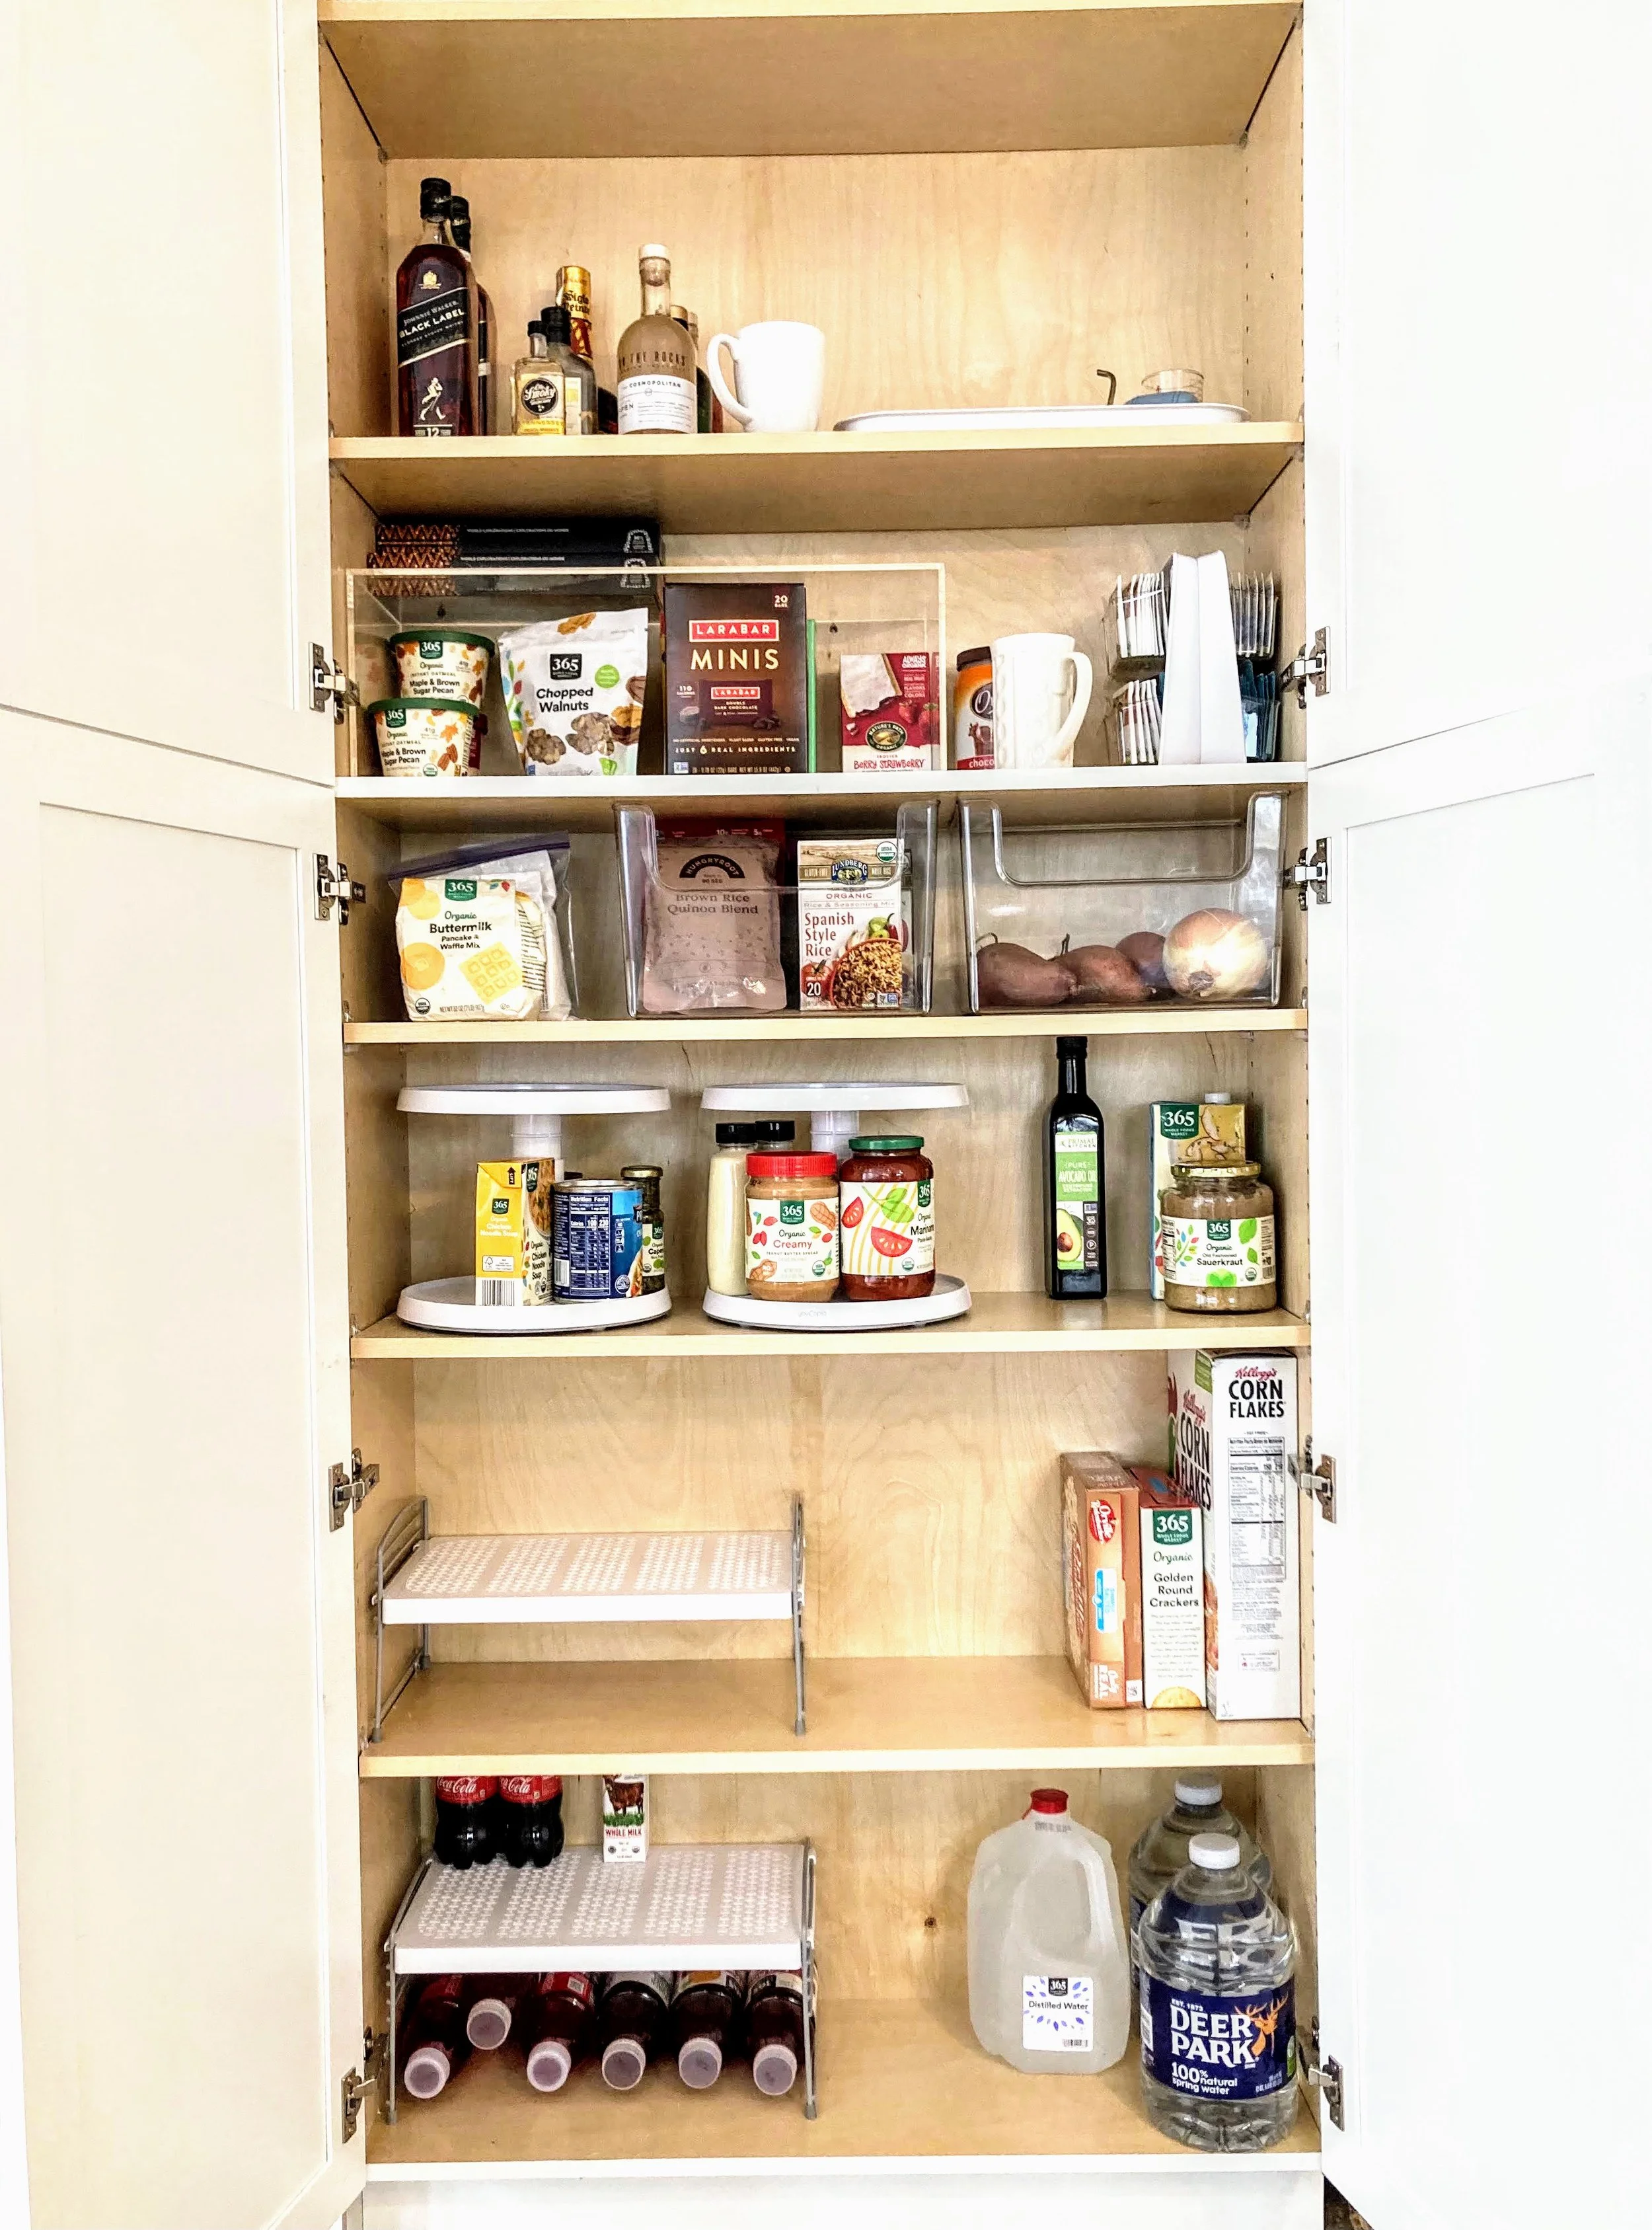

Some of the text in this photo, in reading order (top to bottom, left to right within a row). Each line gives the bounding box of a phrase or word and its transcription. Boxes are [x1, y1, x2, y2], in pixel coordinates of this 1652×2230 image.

[399, 309, 465, 338] BLACK LABEL
[426, 427, 441, 436] 12
[774, 595, 788, 603] 20
[696, 624, 770, 635] LARABAR
[552, 658, 580, 672] 365
[690, 648, 779, 670] MINIS
[437, 678, 461, 687] Brown
[536, 687, 593, 700] Chopped
[539, 701, 589, 712] Walnuts
[699, 745, 708, 755] 6
[685, 857, 739, 875] HUNGRYROOT
[831, 859, 868, 876] LUNDBERG
[447, 882, 474, 892] 365
[676, 893, 750, 902] Brown Rice
[667, 904, 759, 915] Quinoa Blend
[444, 910, 477, 922] Organic
[804, 911, 854, 929] Spanish
[430, 921, 492, 933] Buttermilk
[805, 927, 837, 944] Style
[806, 943, 832, 956] Rice
[807, 982, 821, 996] 20
[1164, 1109, 1195, 1127] 365
[493, 1200, 507, 1209] 365
[782, 1205, 803, 1217] 365
[1209, 1222, 1229, 1233] 365
[778, 1229, 806, 1239] Organic
[773, 1240, 813, 1249] Creamy
[1206, 1243, 1233, 1252] Organic
[1197, 1258, 1243, 1266] Sauerkraut
[1228, 1379, 1283, 1400] CORN
[1229, 1401, 1285, 1418] FLAKES
[1180, 1412, 1210, 1474] CORN
[1181, 1455, 1212, 1512] FLAKES
[1156, 1514, 1189, 1533] 365
[1153, 1551, 1193, 1565] Organic
[1154, 1572, 1193, 1582] Golden
[1158, 1585, 1193, 1595] Round
[1150, 1597, 1199, 1607] Crackers
[1051, 1980, 1067, 1991] 365
[1029, 2001, 1061, 2009] Distilled
[1171, 1998, 1185, 2009] EST.
[1170, 2003, 1254, 2039] DEER
[1171, 2030, 1256, 2068] PARK
[1172, 2062, 1209, 2083] 100%
[1200, 2077, 1238, 2087] natural
[1172, 2077, 1230, 2095] spring water
